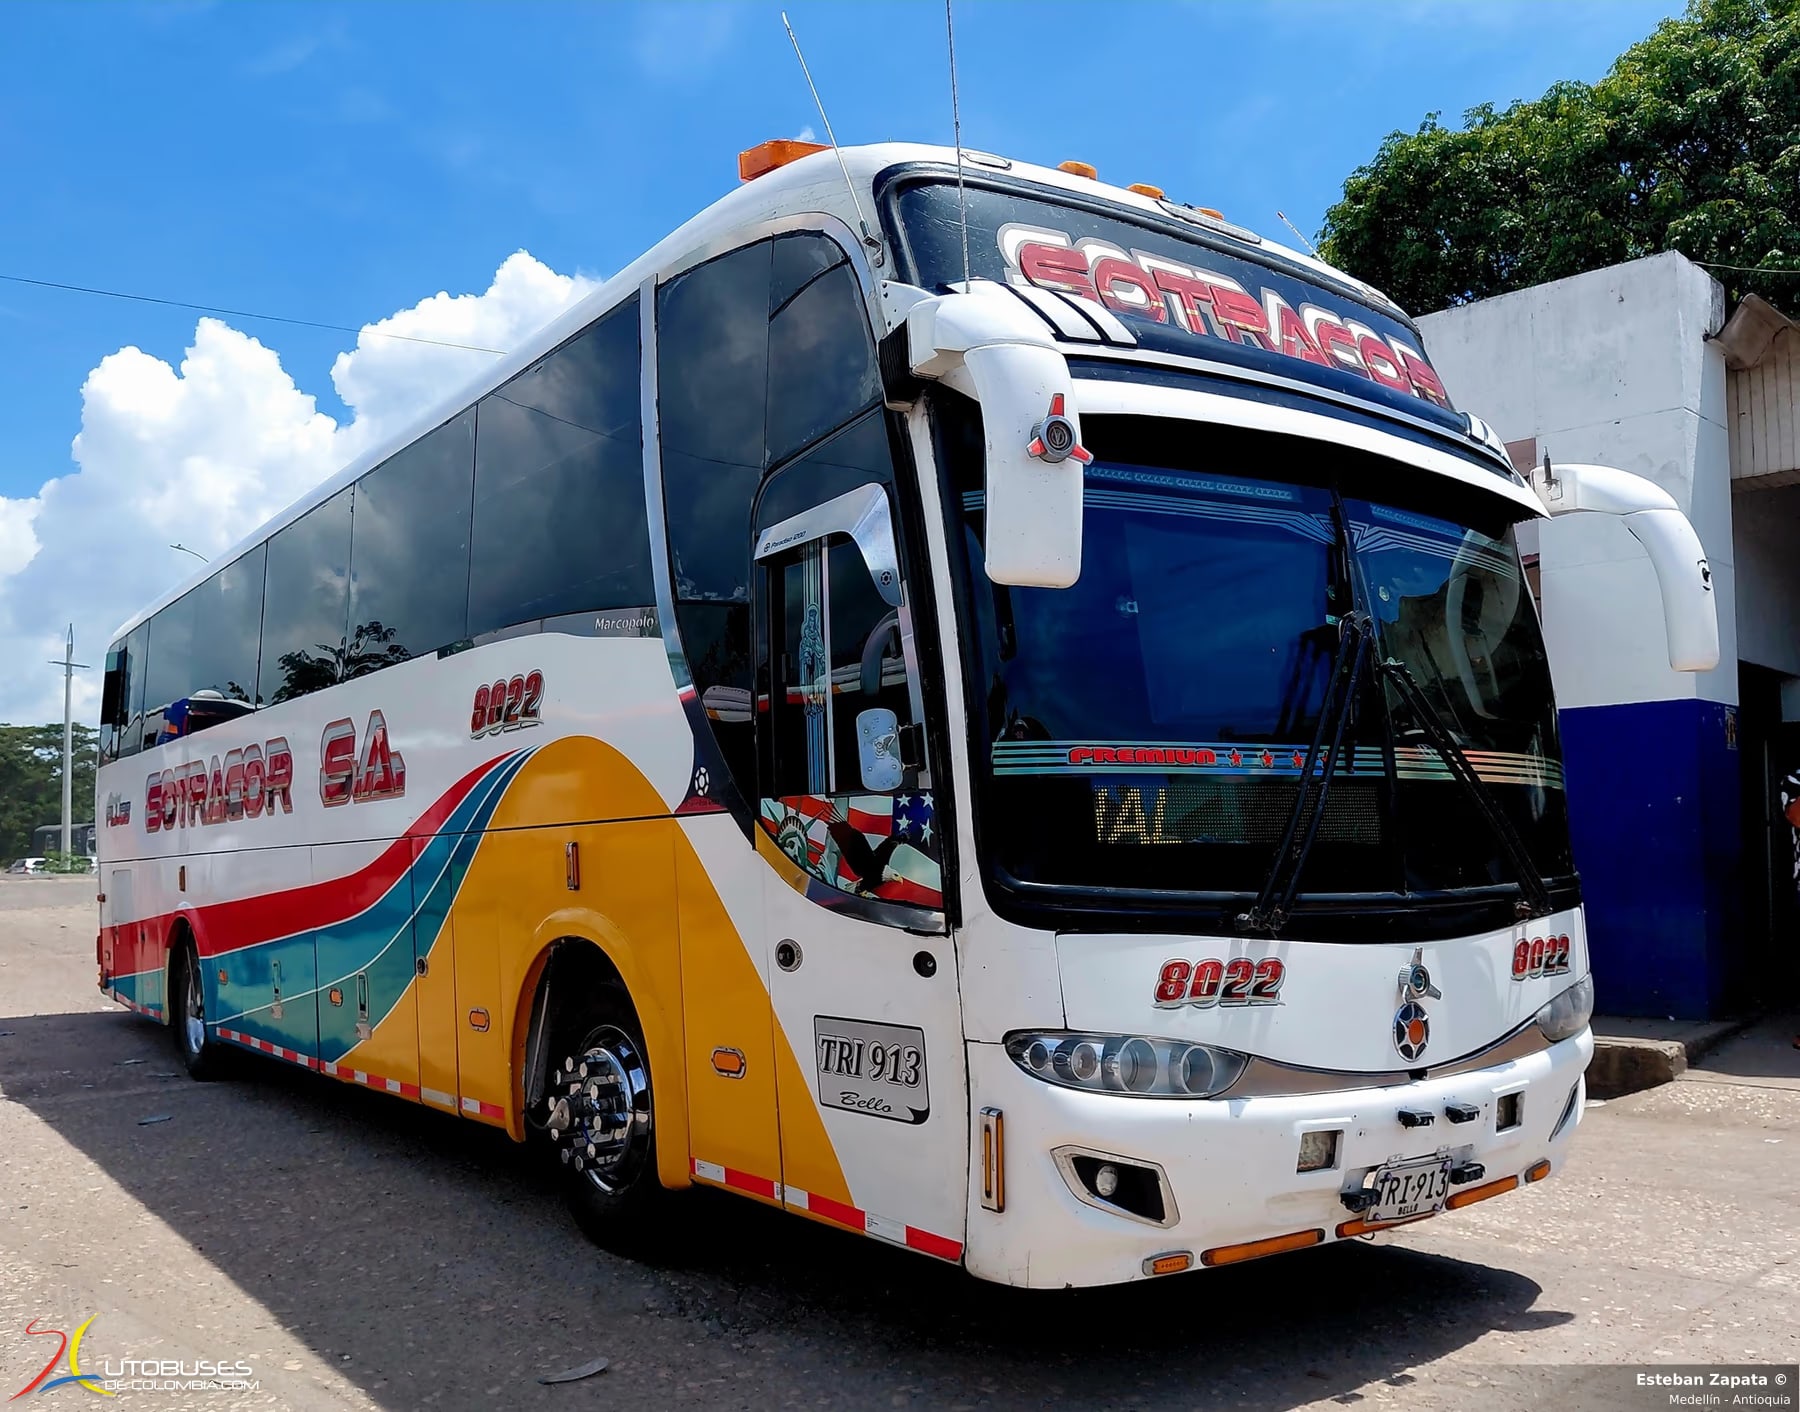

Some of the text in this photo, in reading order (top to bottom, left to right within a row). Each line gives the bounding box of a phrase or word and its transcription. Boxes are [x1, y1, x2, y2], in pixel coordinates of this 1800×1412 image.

[998, 222, 1454, 410] SOTRACOR
[594, 615, 655, 632] Marcopolo
[469, 668, 546, 740] 8022
[1067, 746, 1217, 766] PREMIUN
[145, 736, 294, 834] SOTRACOR
[1152, 957, 1287, 1009] 8022
[1513, 934, 1572, 981] 8022
[818, 1033, 923, 1089] TRI 913
[839, 1090, 893, 1113] Bello
